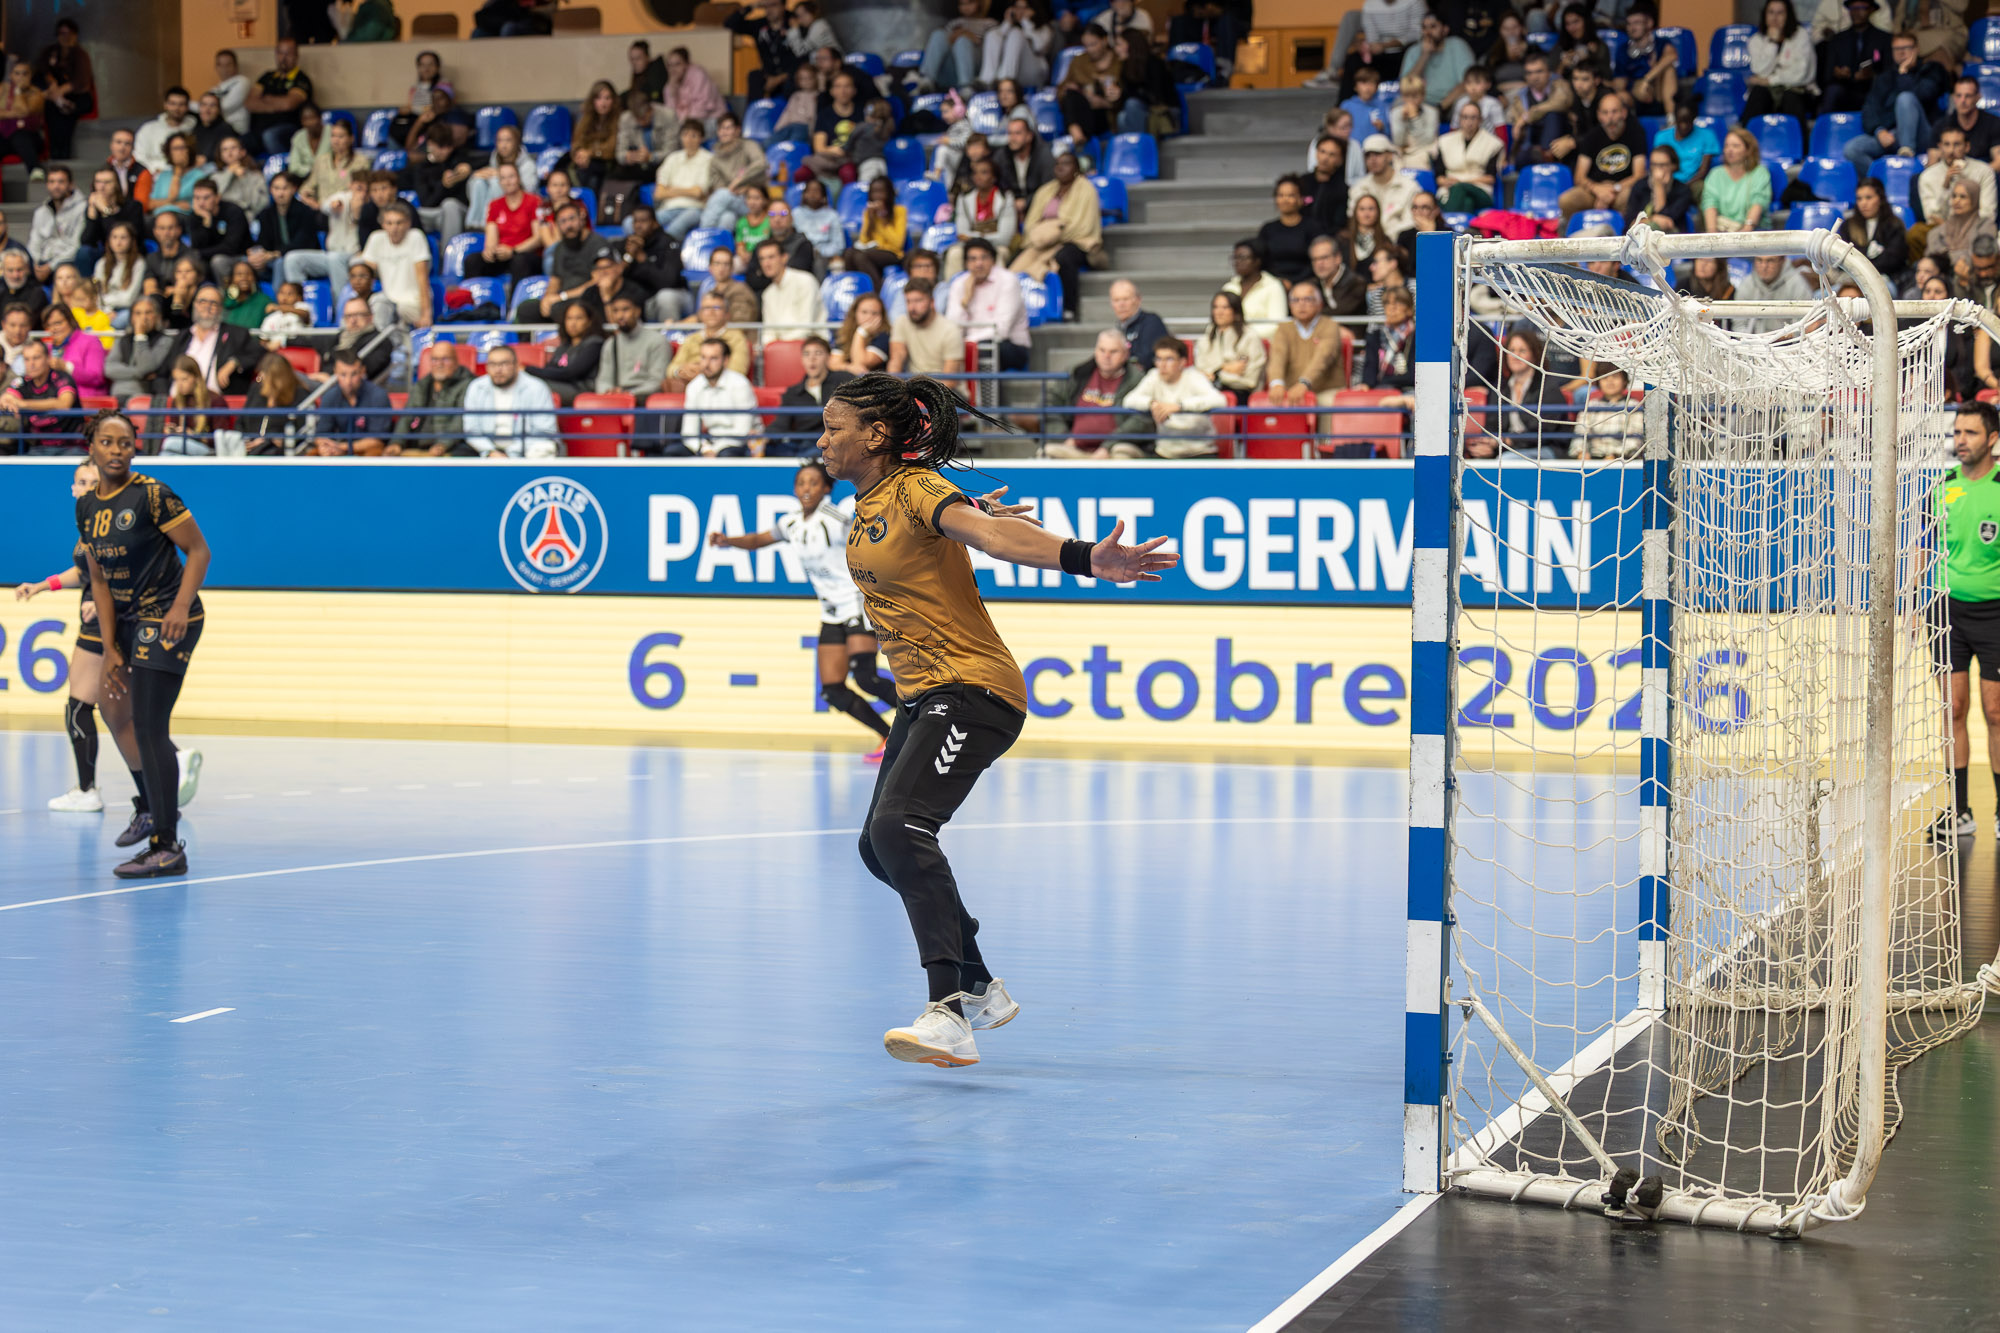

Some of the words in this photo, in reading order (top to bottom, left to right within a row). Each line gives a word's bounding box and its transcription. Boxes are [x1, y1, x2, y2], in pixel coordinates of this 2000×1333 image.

[92, 508, 112, 538] 18
[517, 483, 589, 513] PARIS
[648, 494, 857, 583] PAR
[966, 497, 1592, 594] NT-GERMAIN
[850, 567, 877, 584] PARIS
[0, 620, 69, 692] 6
[628, 632, 686, 710] 6
[1022, 637, 1407, 727] ctobre
